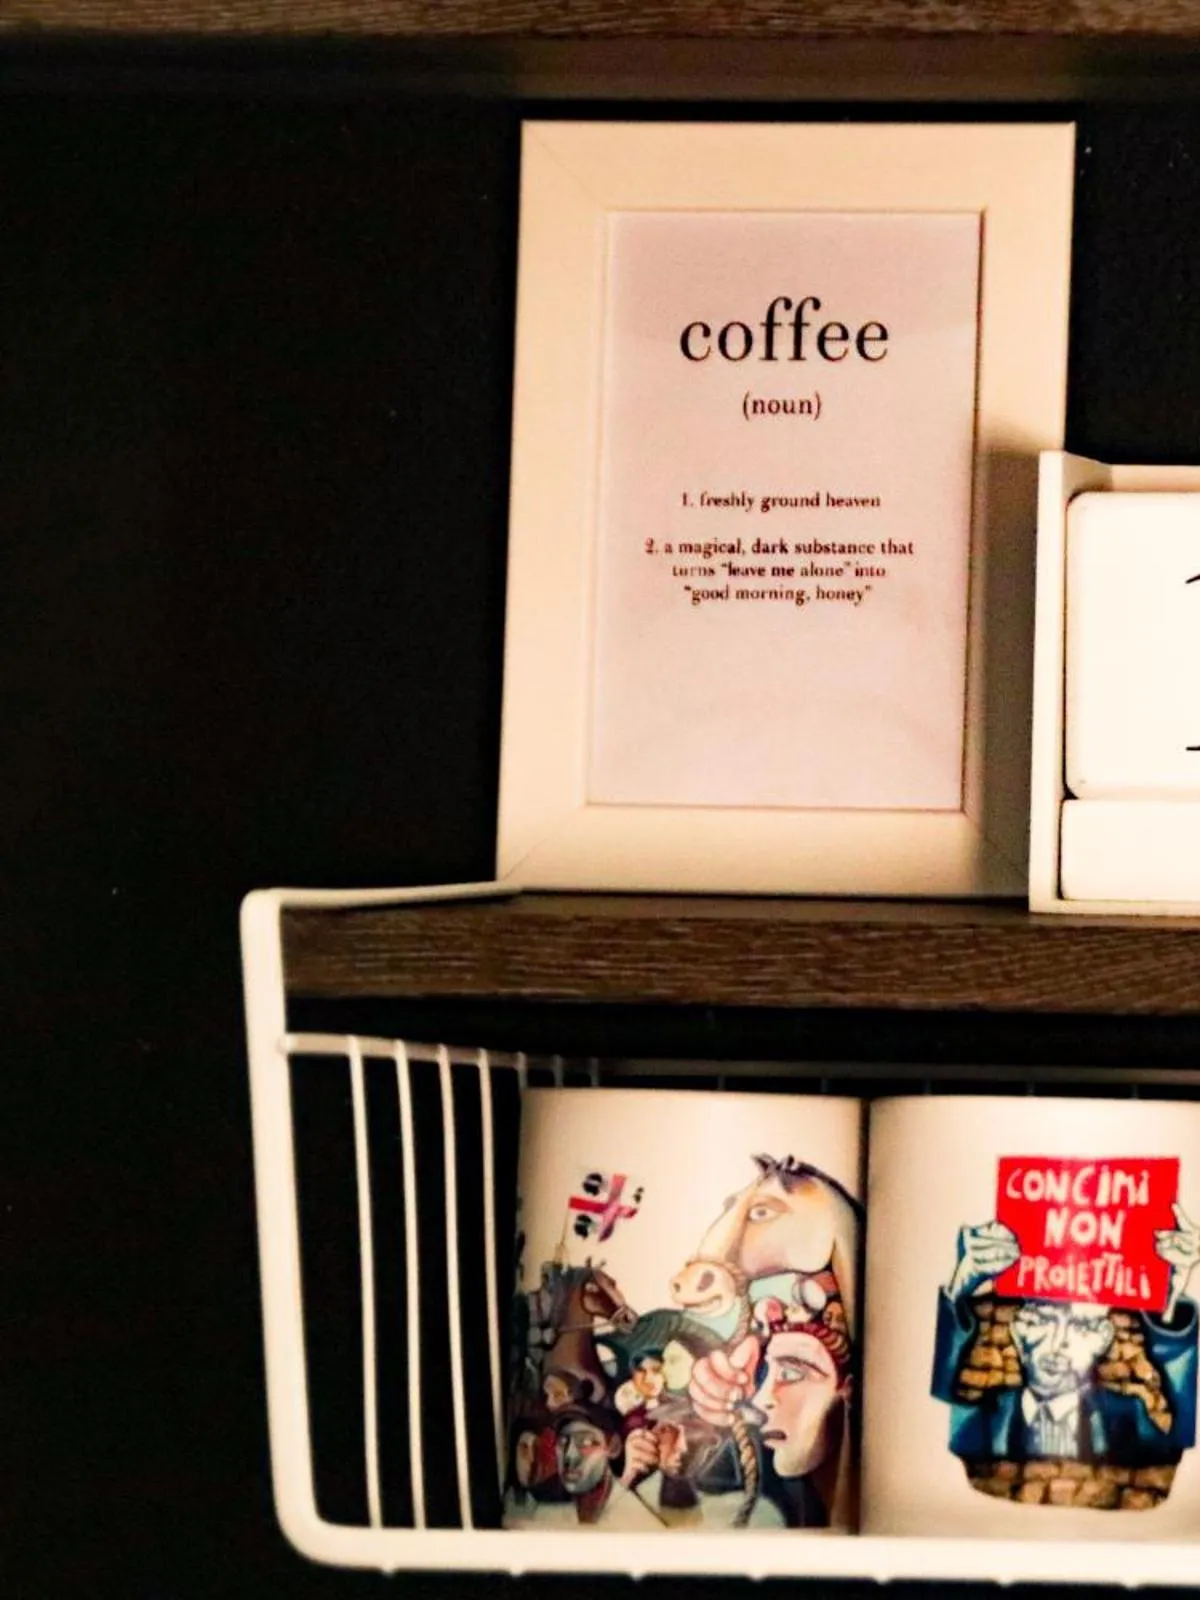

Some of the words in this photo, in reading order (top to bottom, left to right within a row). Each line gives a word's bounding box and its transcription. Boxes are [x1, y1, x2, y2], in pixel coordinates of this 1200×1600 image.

[680, 296, 889, 361] coffee
[743, 391, 822, 420] (noun)
[682, 492, 694, 507] 1.
[700, 491, 754, 512] freshly
[761, 491, 820, 512] ground
[826, 491, 881, 507] heaven
[645, 538, 659, 555] 2.
[664, 542, 673, 554] a
[678, 537, 745, 558] magical,
[751, 538, 789, 554] dark
[794, 538, 875, 555] substance
[881, 538, 914, 555] that
[672, 562, 716, 577] turns
[771, 565, 795, 577] me
[854, 562, 886, 577] into
[735, 584, 811, 605] morning,
[1044, 1207, 1125, 1250] NON
